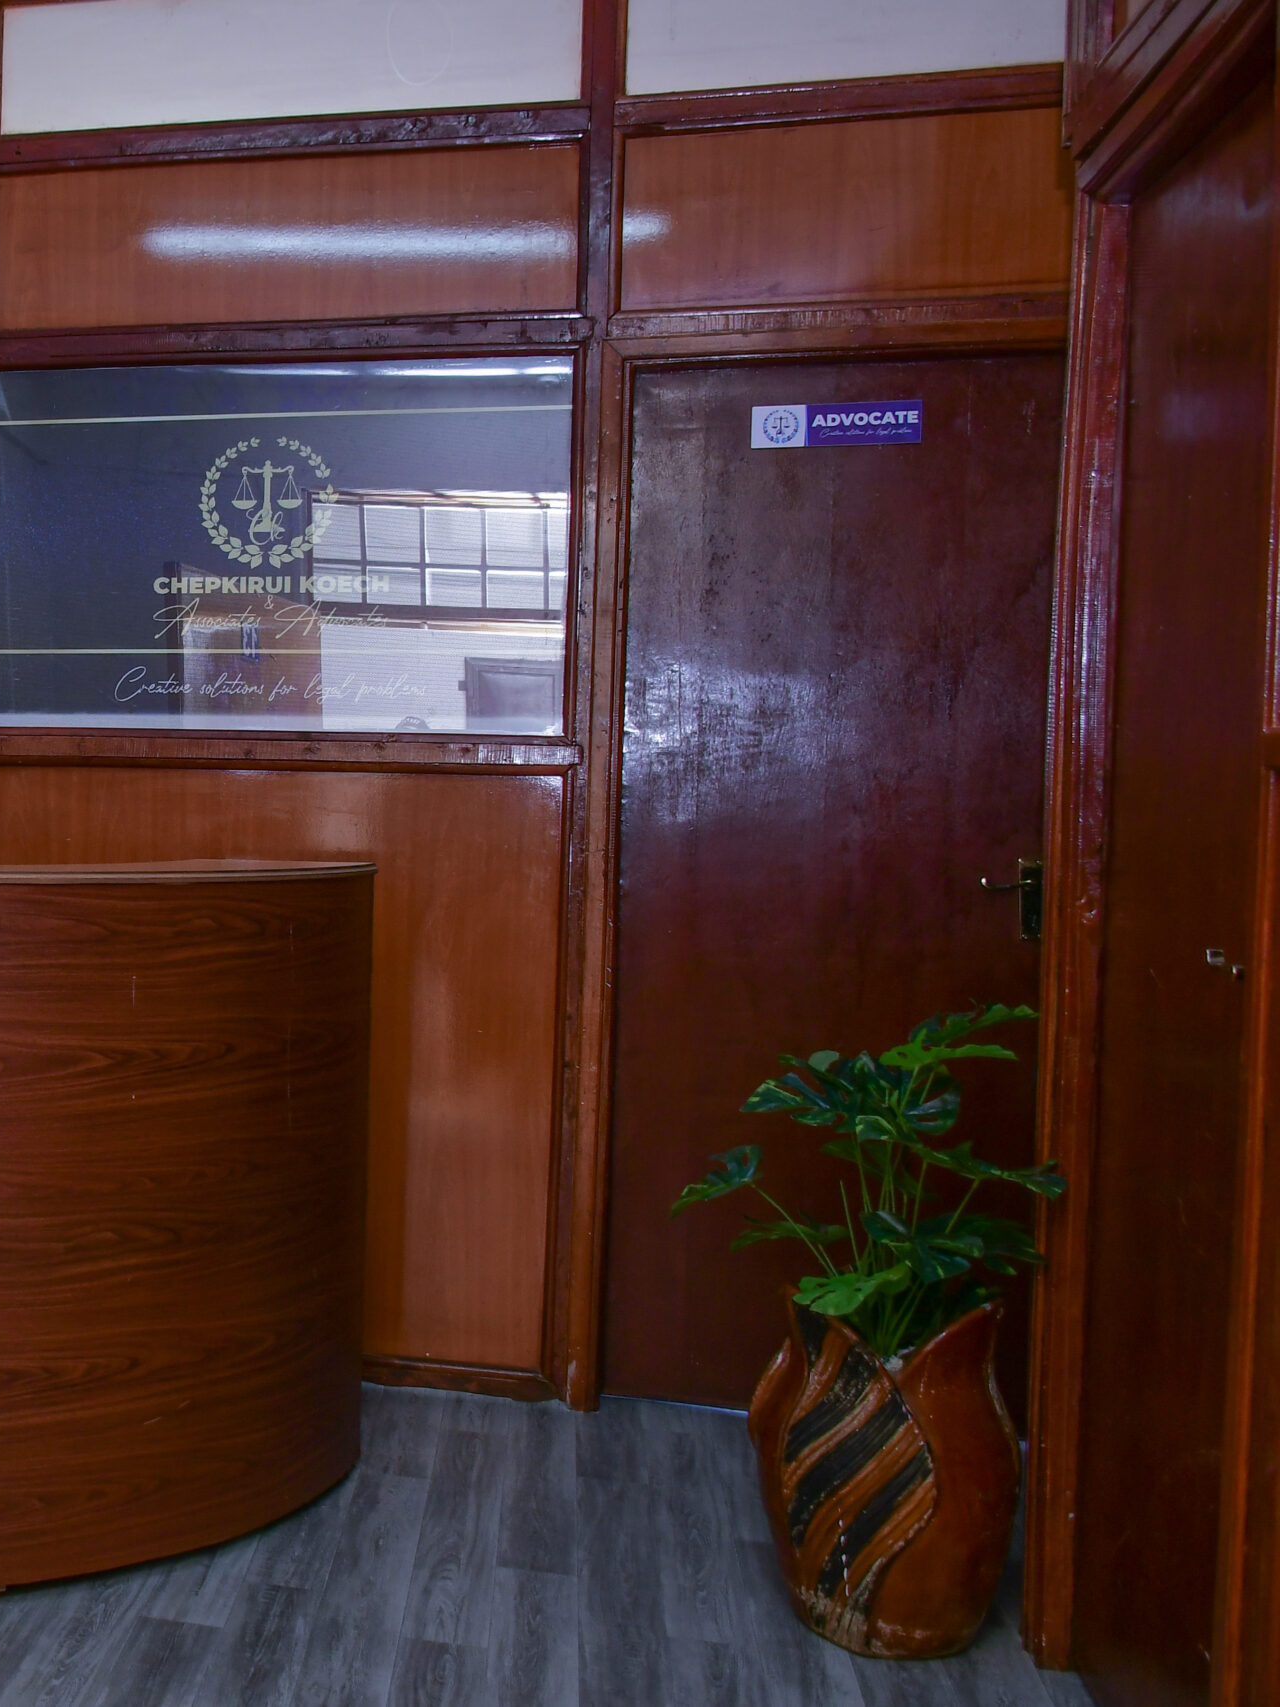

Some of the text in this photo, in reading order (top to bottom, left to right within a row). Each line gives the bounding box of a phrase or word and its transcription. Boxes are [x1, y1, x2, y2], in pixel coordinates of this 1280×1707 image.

[811, 410, 919, 428] ADVOCATE
[153, 575, 390, 594] CHEPKIRUI KOECH
[263, 595, 274, 610] &
[152, 597, 261, 640] Associates
[114, 666, 193, 701] Creative
[199, 672, 264, 697] solutions
[268, 676, 297, 701] for
[303, 673, 354, 703] legal
